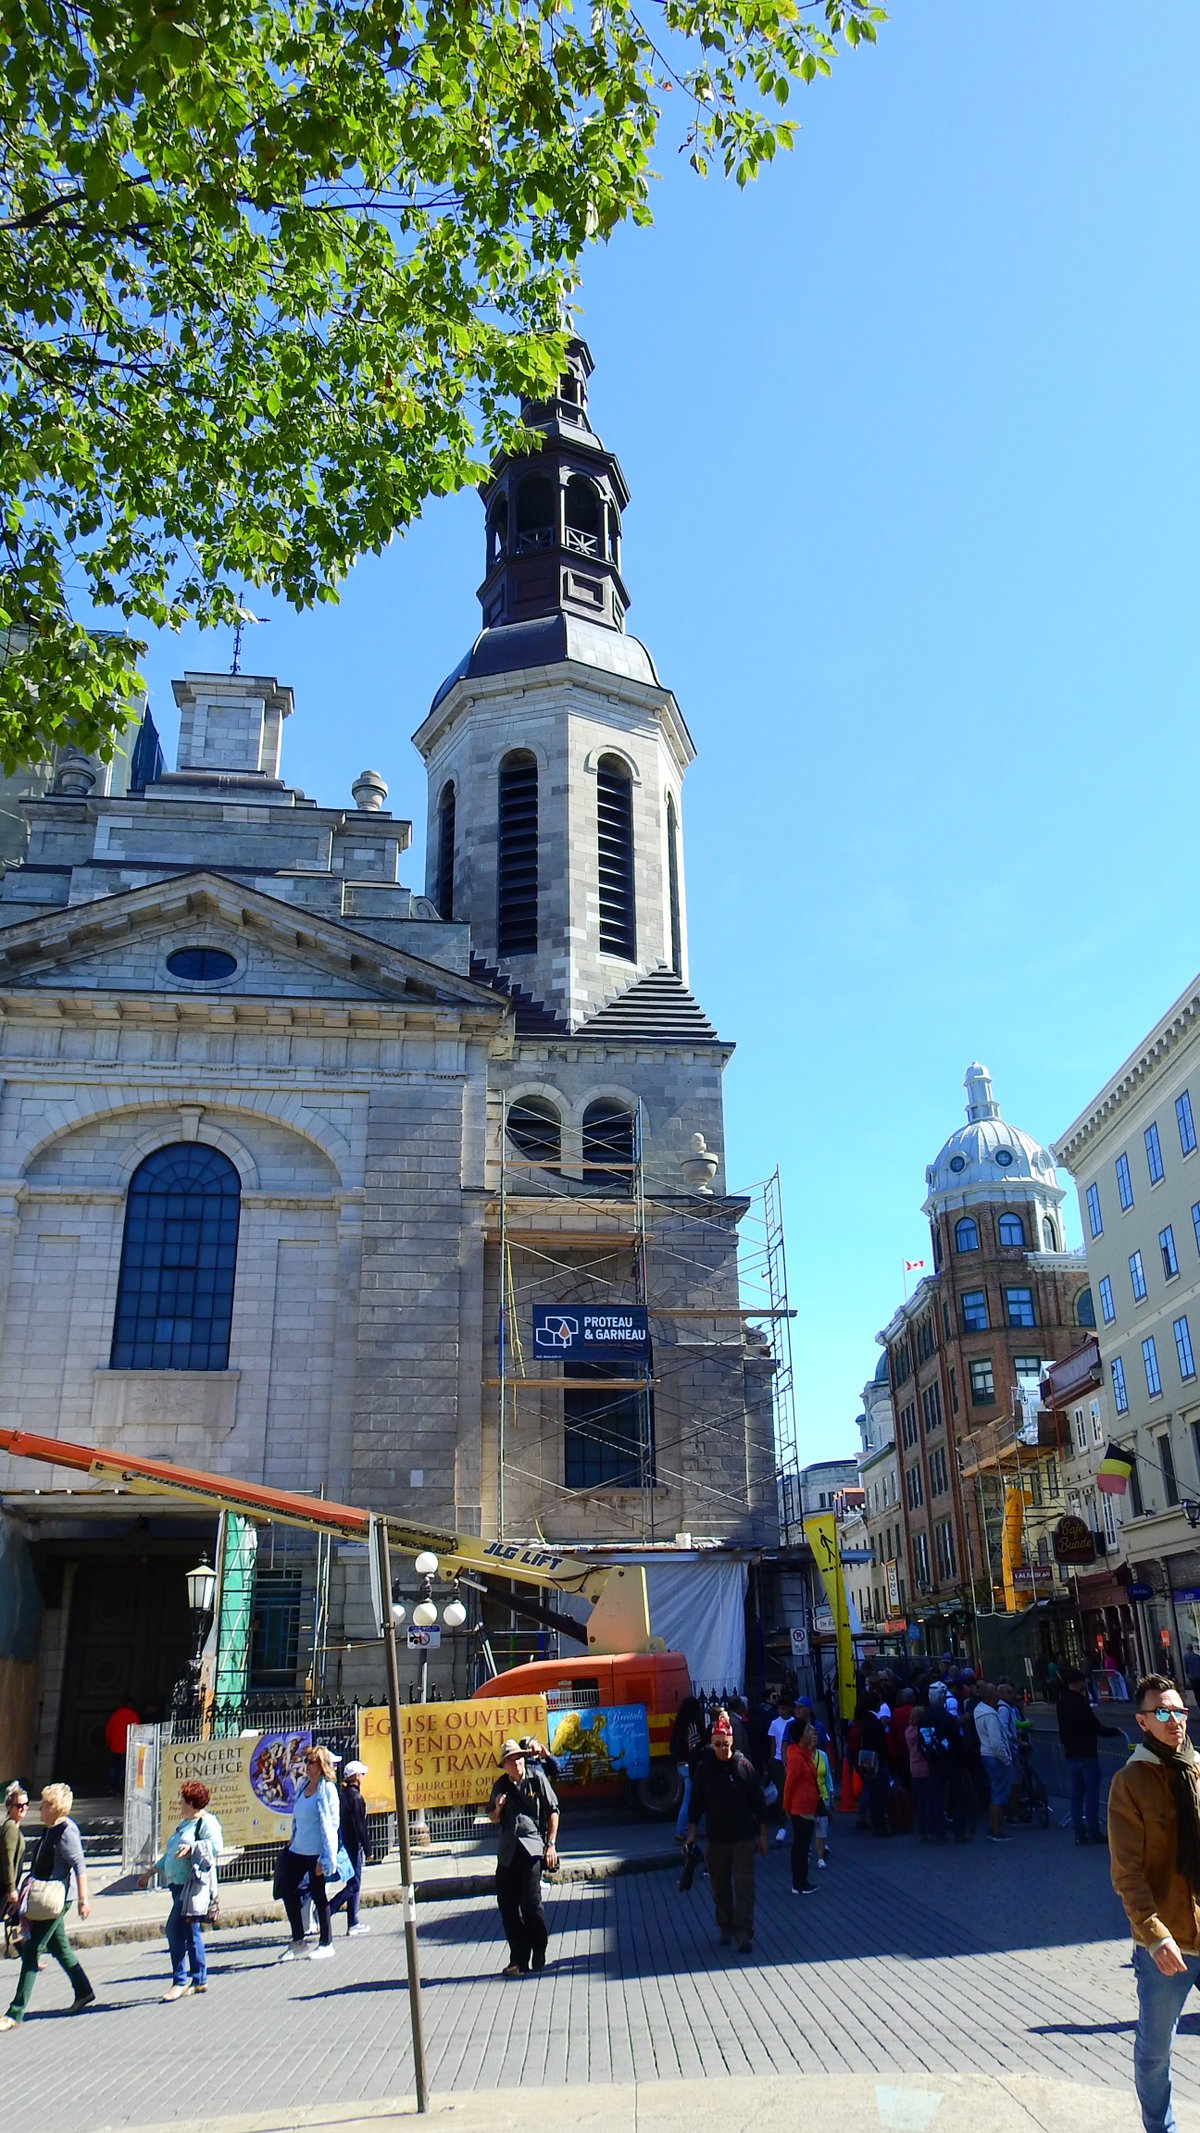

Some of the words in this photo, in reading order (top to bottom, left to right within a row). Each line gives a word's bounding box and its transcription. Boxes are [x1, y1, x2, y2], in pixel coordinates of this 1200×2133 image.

[584, 1316, 633, 1328] PROTEAU
[584, 1329, 593, 1340] &
[595, 1329, 646, 1341] GARNEAU
[1060, 1520, 1085, 1540] Café
[1057, 1536, 1092, 1553] Buade
[483, 1542, 520, 1560] JLG
[519, 1550, 564, 1571] LIFT
[364, 1711, 437, 1737] ÉGISE
[446, 1705, 545, 1729] OUVERTE
[403, 1729, 509, 1755] PENDANT
[173, 1747, 244, 1765] CONCERT
[431, 1752, 499, 1774] TRAVA
[406, 1779, 458, 1793] CHURCH
[462, 1778, 472, 1788] IS
[475, 1776, 498, 1787] OPE
[407, 1789, 445, 1804] URING
[450, 1788, 472, 1800] THE
